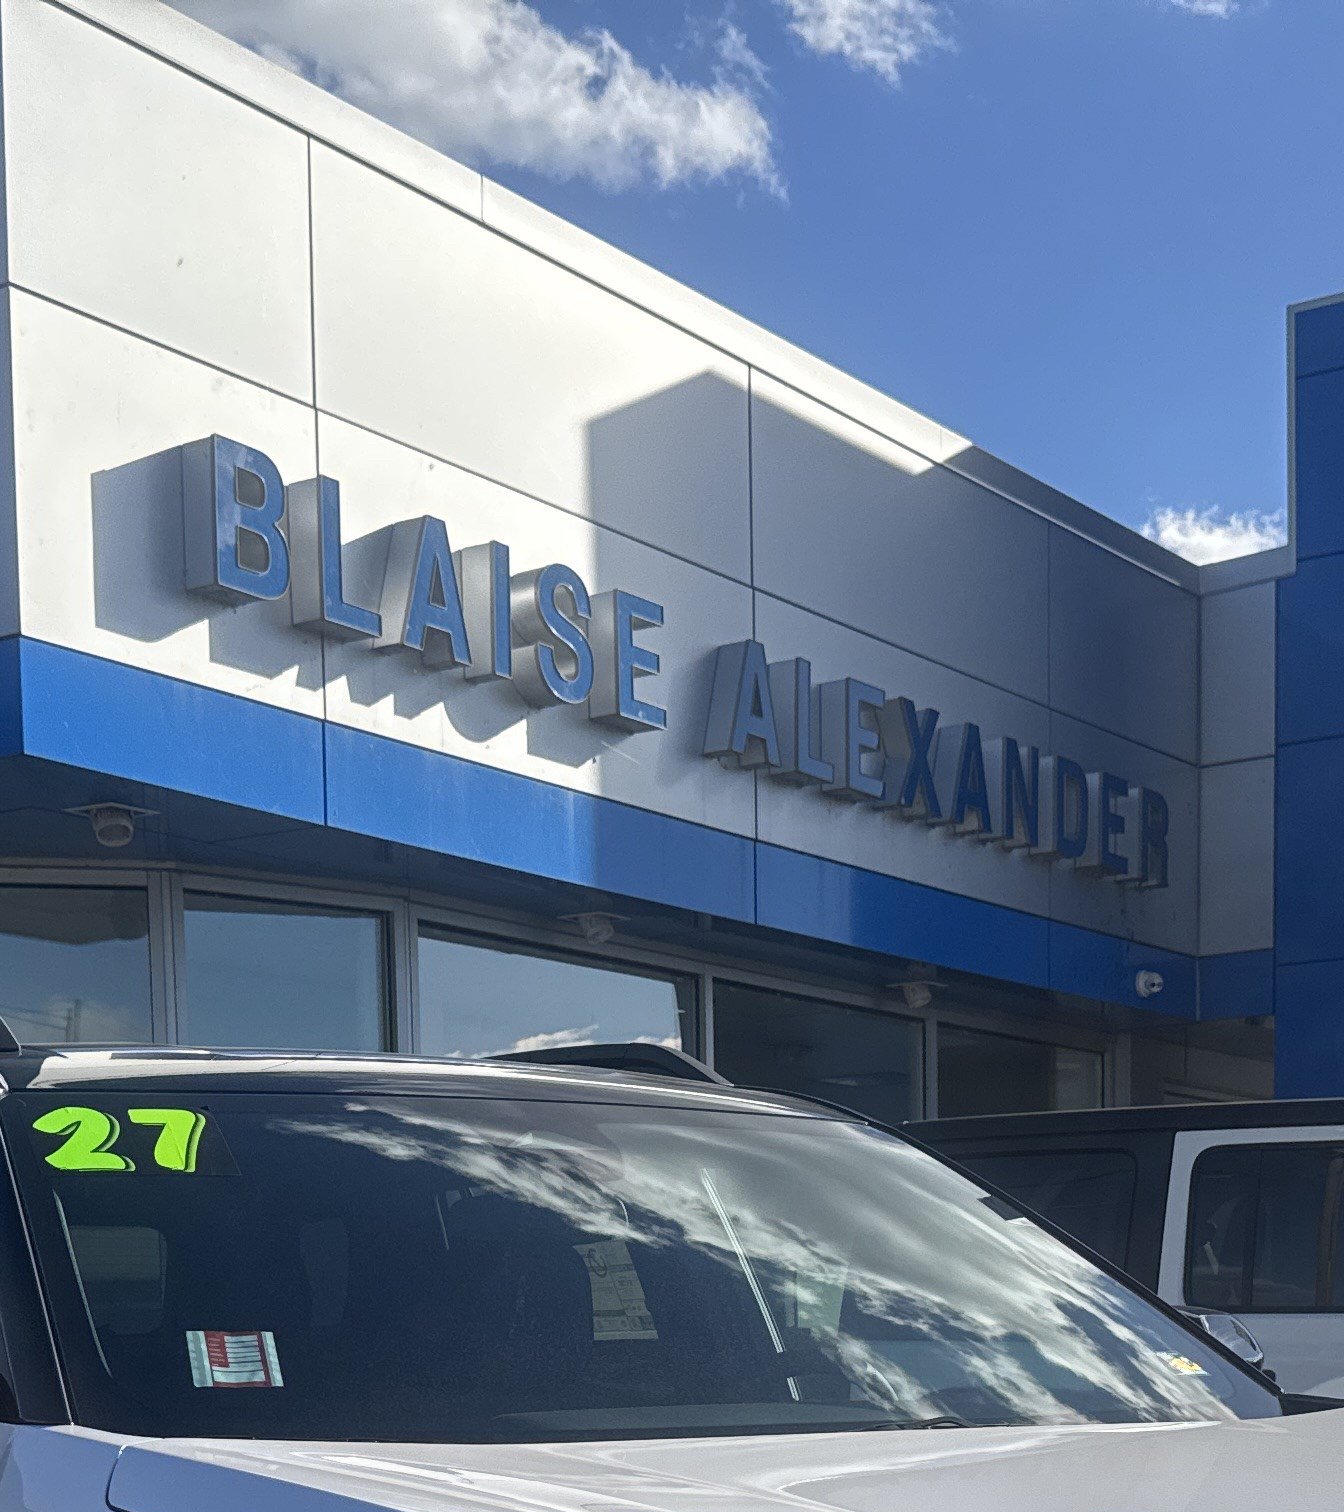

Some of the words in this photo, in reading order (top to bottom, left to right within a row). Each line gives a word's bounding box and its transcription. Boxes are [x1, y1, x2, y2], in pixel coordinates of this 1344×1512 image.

[208, 432, 668, 732] BLAISE
[720, 638, 1170, 890] ALEXANDER
[32, 1106, 206, 1173] 27
